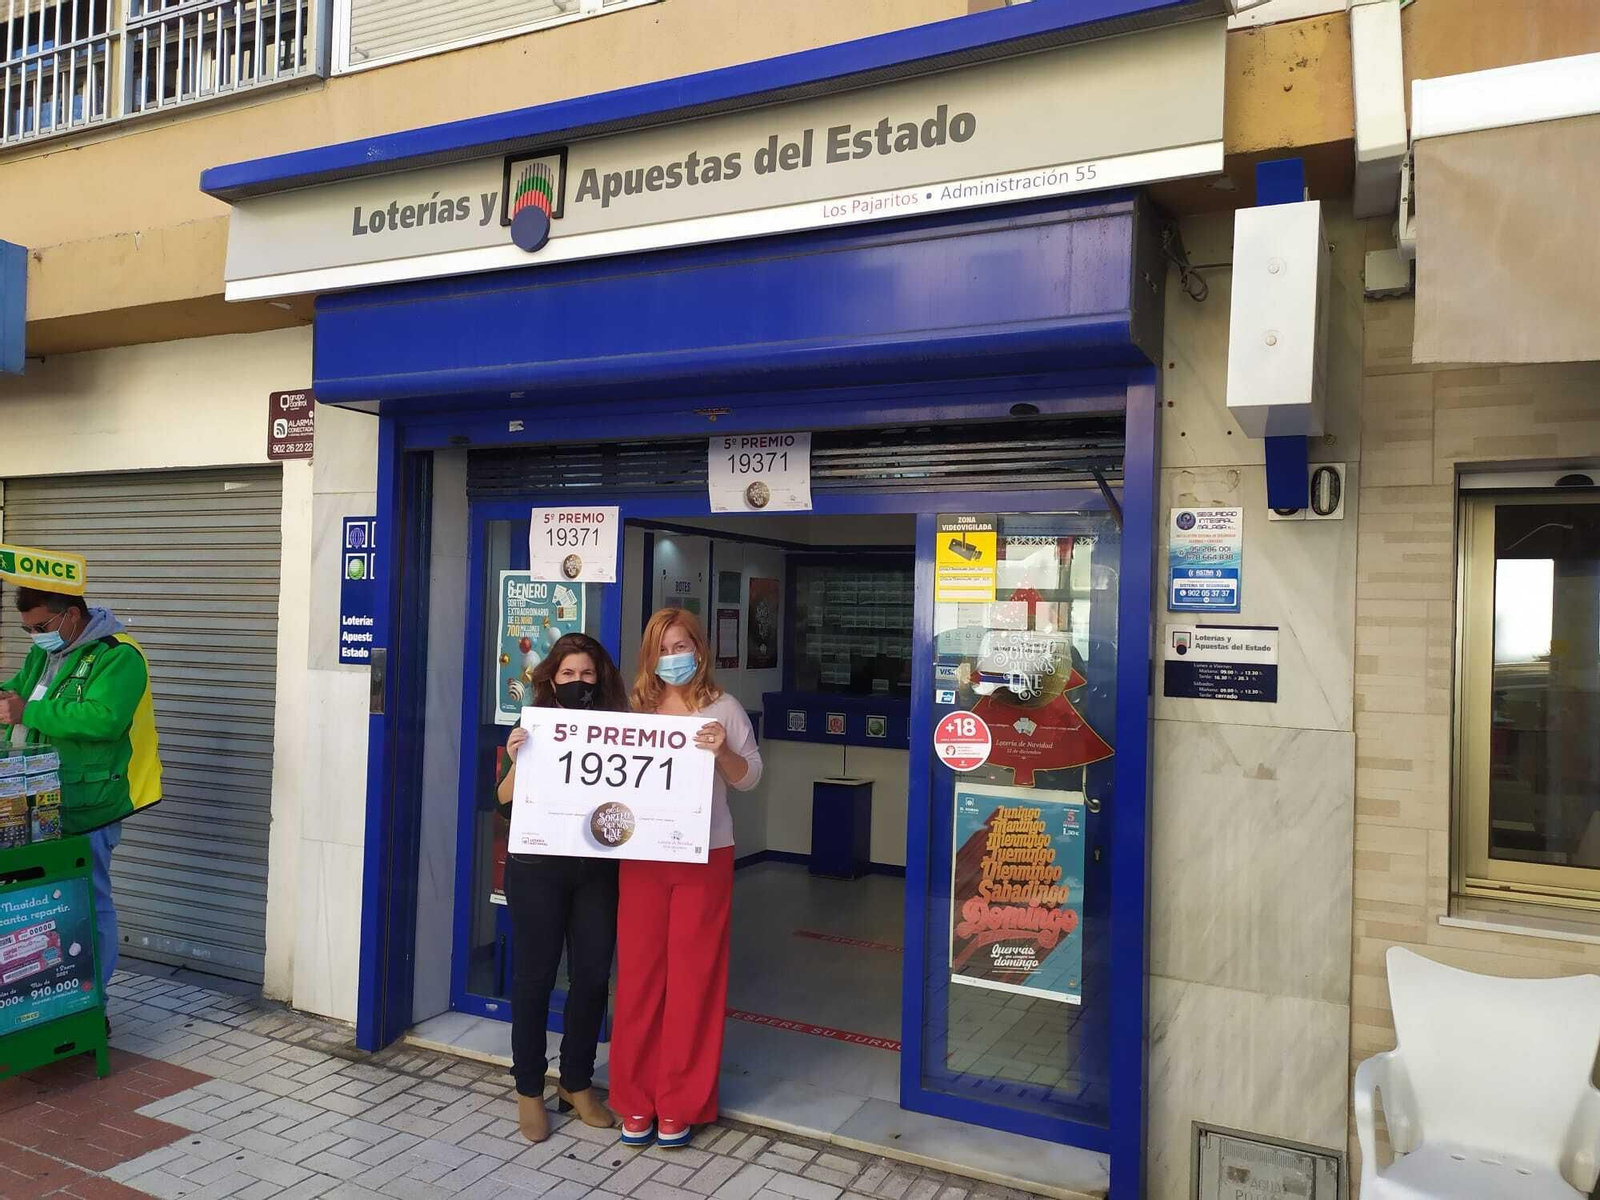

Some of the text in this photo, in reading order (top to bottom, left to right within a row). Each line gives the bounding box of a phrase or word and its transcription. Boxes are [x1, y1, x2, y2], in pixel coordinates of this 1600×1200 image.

[352, 104, 977, 236] Loterías y Apuestas del Estado
[822, 164, 1097, 219] Los Pajaritos Administración 55
[288, 419, 314, 427] ALARMA
[273, 443, 313, 453] 902 26 22 22
[724, 435, 795, 450] 5º PREMIO
[728, 451, 788, 474] 19371
[544, 512, 605, 524] 5º PREMIO
[958, 516, 976, 524] ZONA
[942, 523, 992, 531] VIDEOVIGILADA
[546, 527, 600, 547] 19371
[20, 557, 76, 580] ONCE
[507, 624, 520, 637] 700
[1227, 635, 1232, 643] y
[341, 647, 369, 658] Estado
[1245, 644, 1272, 652] Estado
[945, 717, 977, 737] +18
[553, 723, 687, 750] 5º PREMIO
[1027, 741, 1054, 749] Navidad
[558, 750, 674, 790] 19371
[1, 894, 49, 913] Navidad
[31, 904, 71, 920] repartir.
[29, 923, 52, 936] 00000
[993, 957, 1040, 971] domingo
[30, 978, 79, 1000] 910.000
[732, 1011, 802, 1032] ESPERE
[810, 1027, 836, 1037] SU
